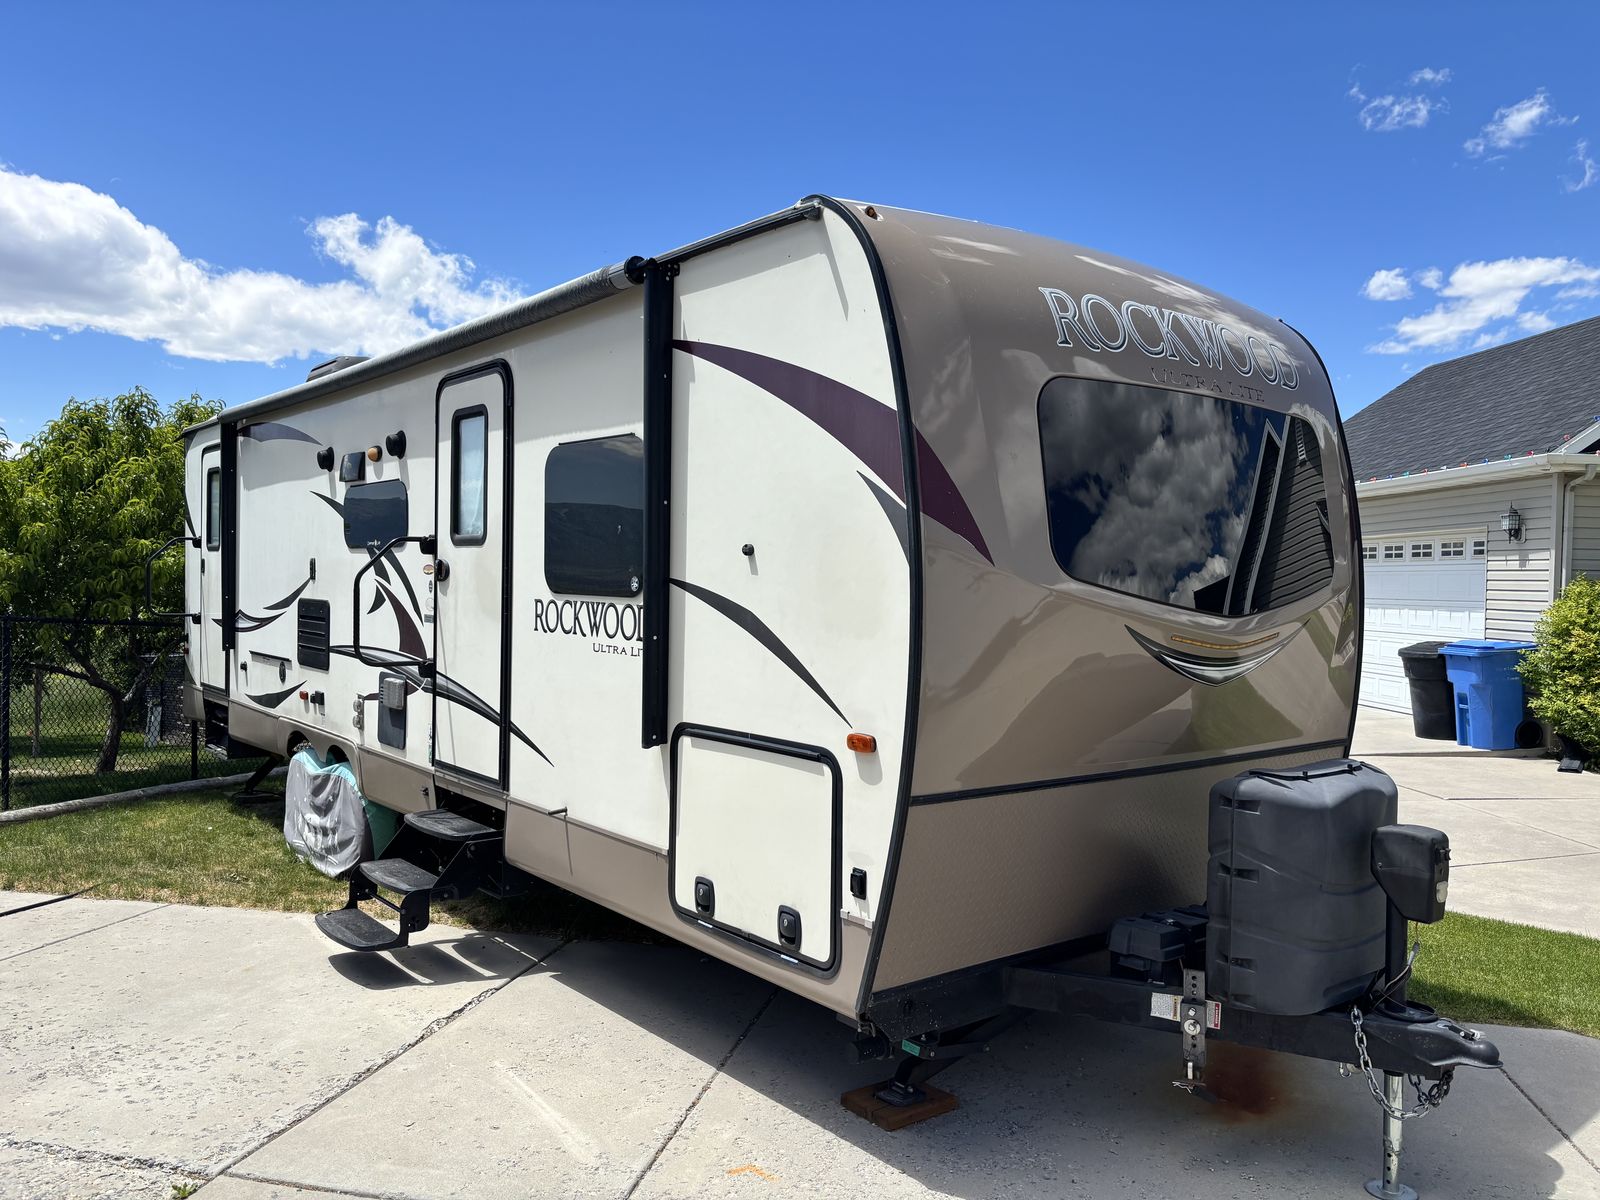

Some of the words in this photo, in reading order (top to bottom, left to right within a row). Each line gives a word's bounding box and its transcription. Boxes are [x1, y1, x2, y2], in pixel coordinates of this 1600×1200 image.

[1038, 286, 1299, 390] ROCKWOOD
[1151, 367, 1222, 392] ULTRA
[1227, 381, 1264, 402] LITE
[592, 642, 627, 655] ULTRA
